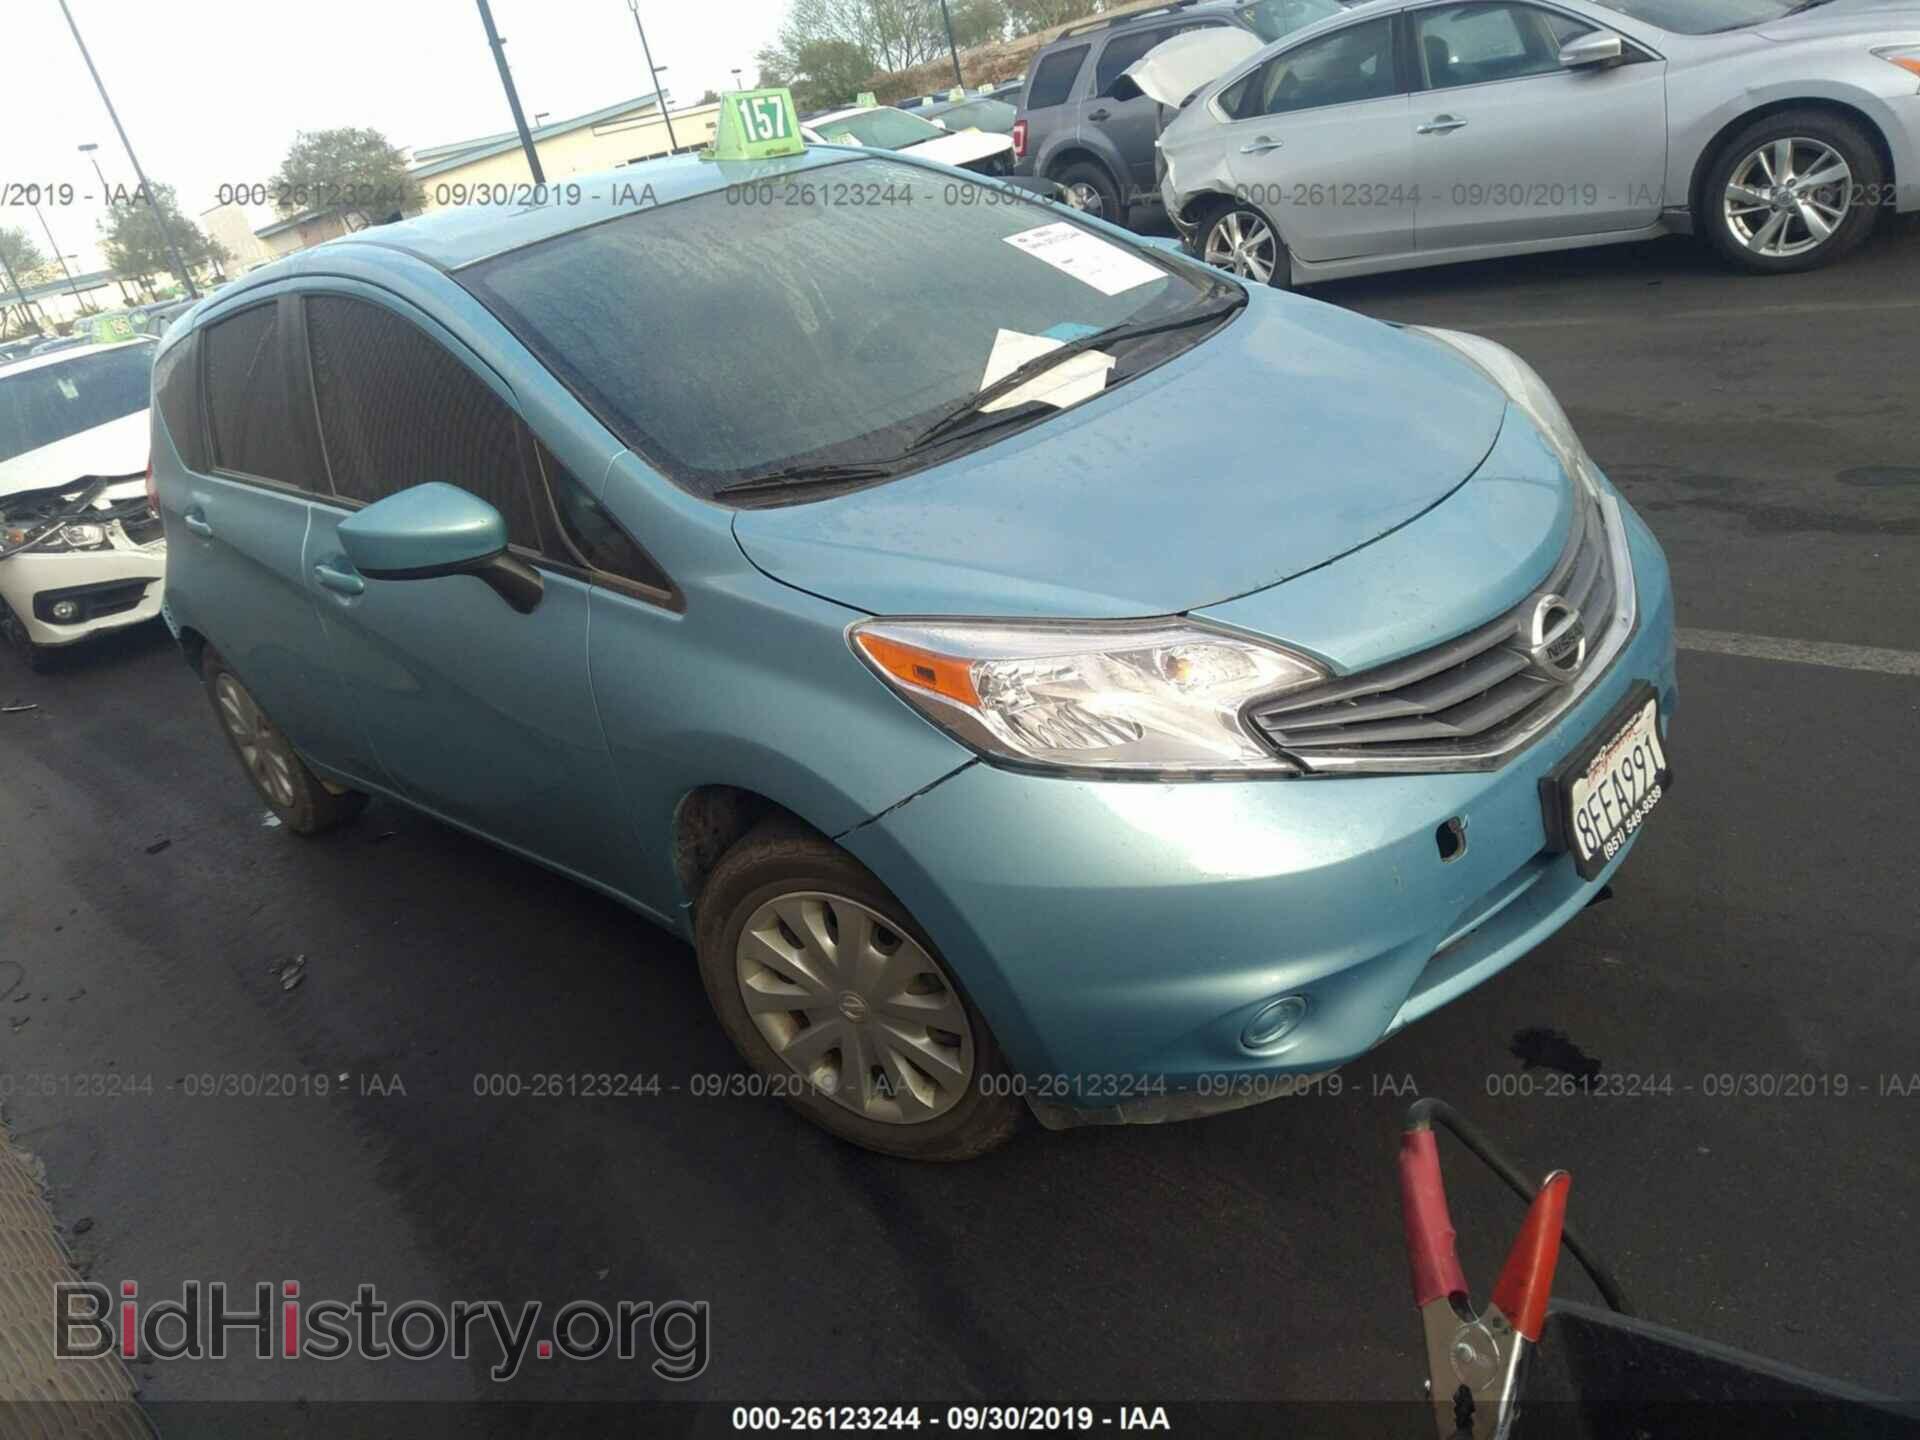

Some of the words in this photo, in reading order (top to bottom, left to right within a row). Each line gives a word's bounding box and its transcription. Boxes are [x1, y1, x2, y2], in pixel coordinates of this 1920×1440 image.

[738, 96, 785, 141] 157
[1546, 621, 1583, 659] NISS
[1577, 735, 1661, 853] 8FFA991
